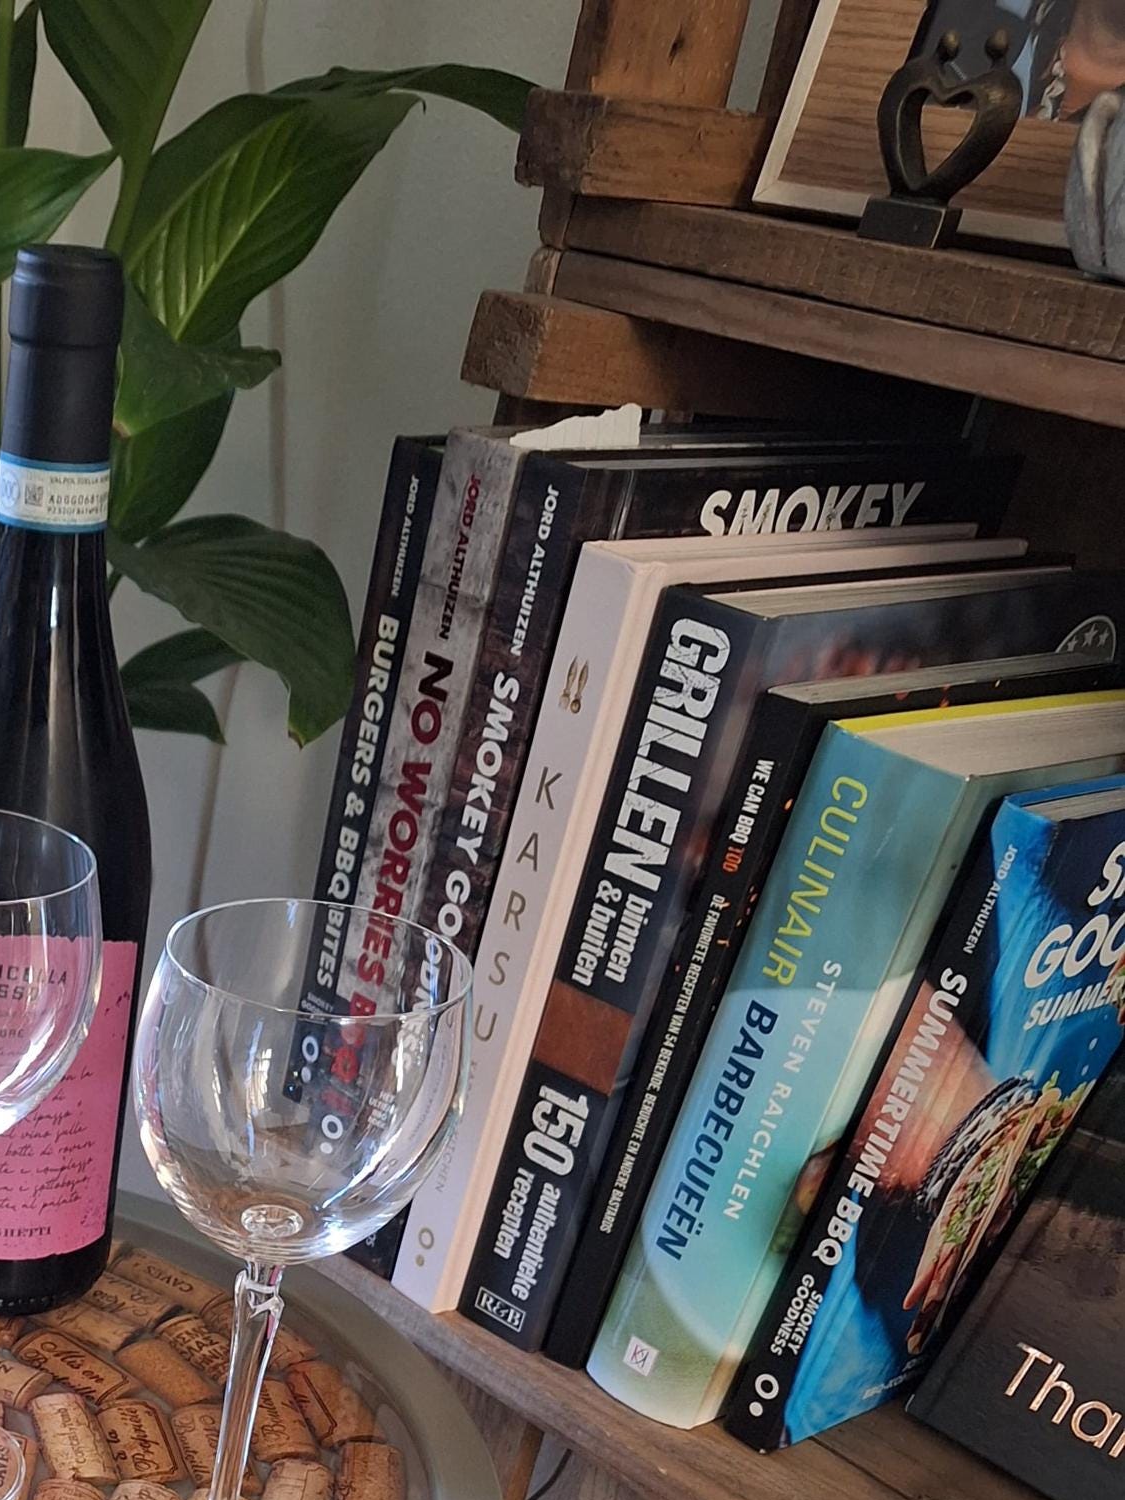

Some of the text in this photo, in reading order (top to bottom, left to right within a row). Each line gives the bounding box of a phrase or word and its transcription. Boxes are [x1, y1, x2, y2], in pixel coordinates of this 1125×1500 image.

[390, 475, 420, 598] JORD ALTHUIZEN
[699, 482, 926, 537] SMOKEY
[438, 473, 483, 641] JORD ALTHUIZEN
[510, 484, 560, 657] JORD ALTHUIZEN
[455, 671, 521, 865] SMOKEY
[603, 617, 731, 893] GRILLEN
[740, 783, 766, 815] CAN
[751, 758, 775, 784] WE
[316, 614, 401, 990] BURGERS & BBQ BITES
[356, 651, 456, 988] NO WORRIES
[728, 814, 755, 846] BBQ
[710, 893, 725, 910] DE
[762, 775, 869, 987] CULINAIR
[962, 843, 1020, 955] JORD ALTHUIZEN
[571, 879, 623, 987] & buiten
[604, 892, 654, 985] binnen
[692, 908, 722, 965] FAVORIETE
[667, 1008, 686, 1034] VAN
[675, 964, 703, 1013] RECEPTEN
[663, 1031, 679, 1048] 54
[522, 1085, 590, 1177] 150
[655, 1000, 780, 1261] BARBECUEËN
[722, 958, 844, 1220] STEVEN RAICHLEN
[810, 967, 969, 1268] SUMMERTIME BBQ
[614, 1152, 639, 1194] ANDERE
[627, 1140, 642, 1155] EN
[492, 1167, 536, 1260] recepten
[510, 1181, 562, 1302] authentieke
[599, 1188, 625, 1235] BASTARDS
[476, 1291, 525, 1328] R&B
[769, 1273, 816, 1357] GOODNESS
[792, 1289, 825, 1357] SMOKEY
